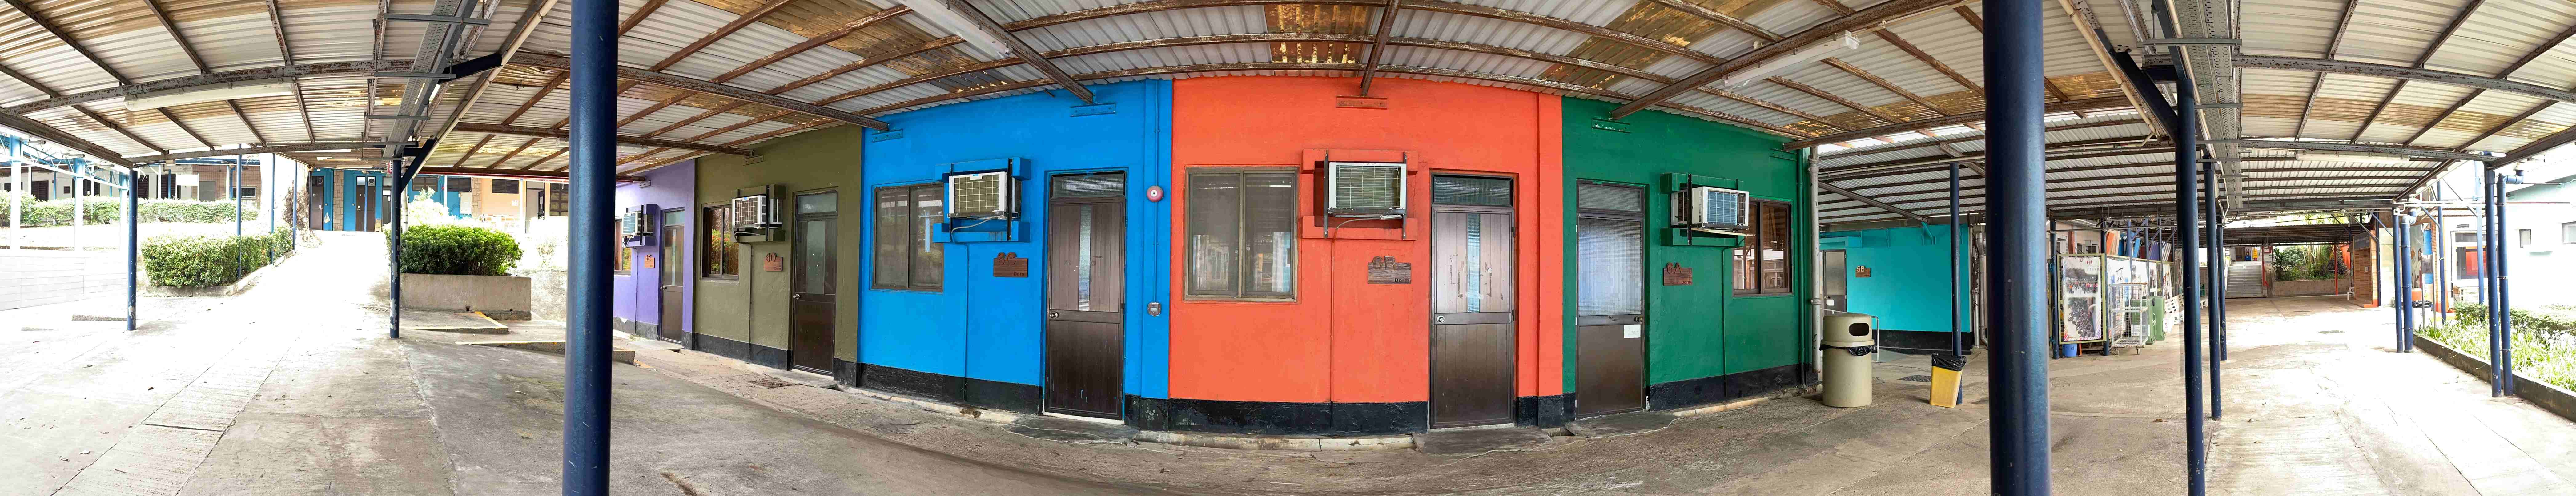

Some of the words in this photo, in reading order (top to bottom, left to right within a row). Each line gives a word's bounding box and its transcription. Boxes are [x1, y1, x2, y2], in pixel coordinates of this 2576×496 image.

[766, 253, 776, 262] 6D
[998, 253, 1015, 265] 6C
[1667, 263, 1682, 275] 6A
